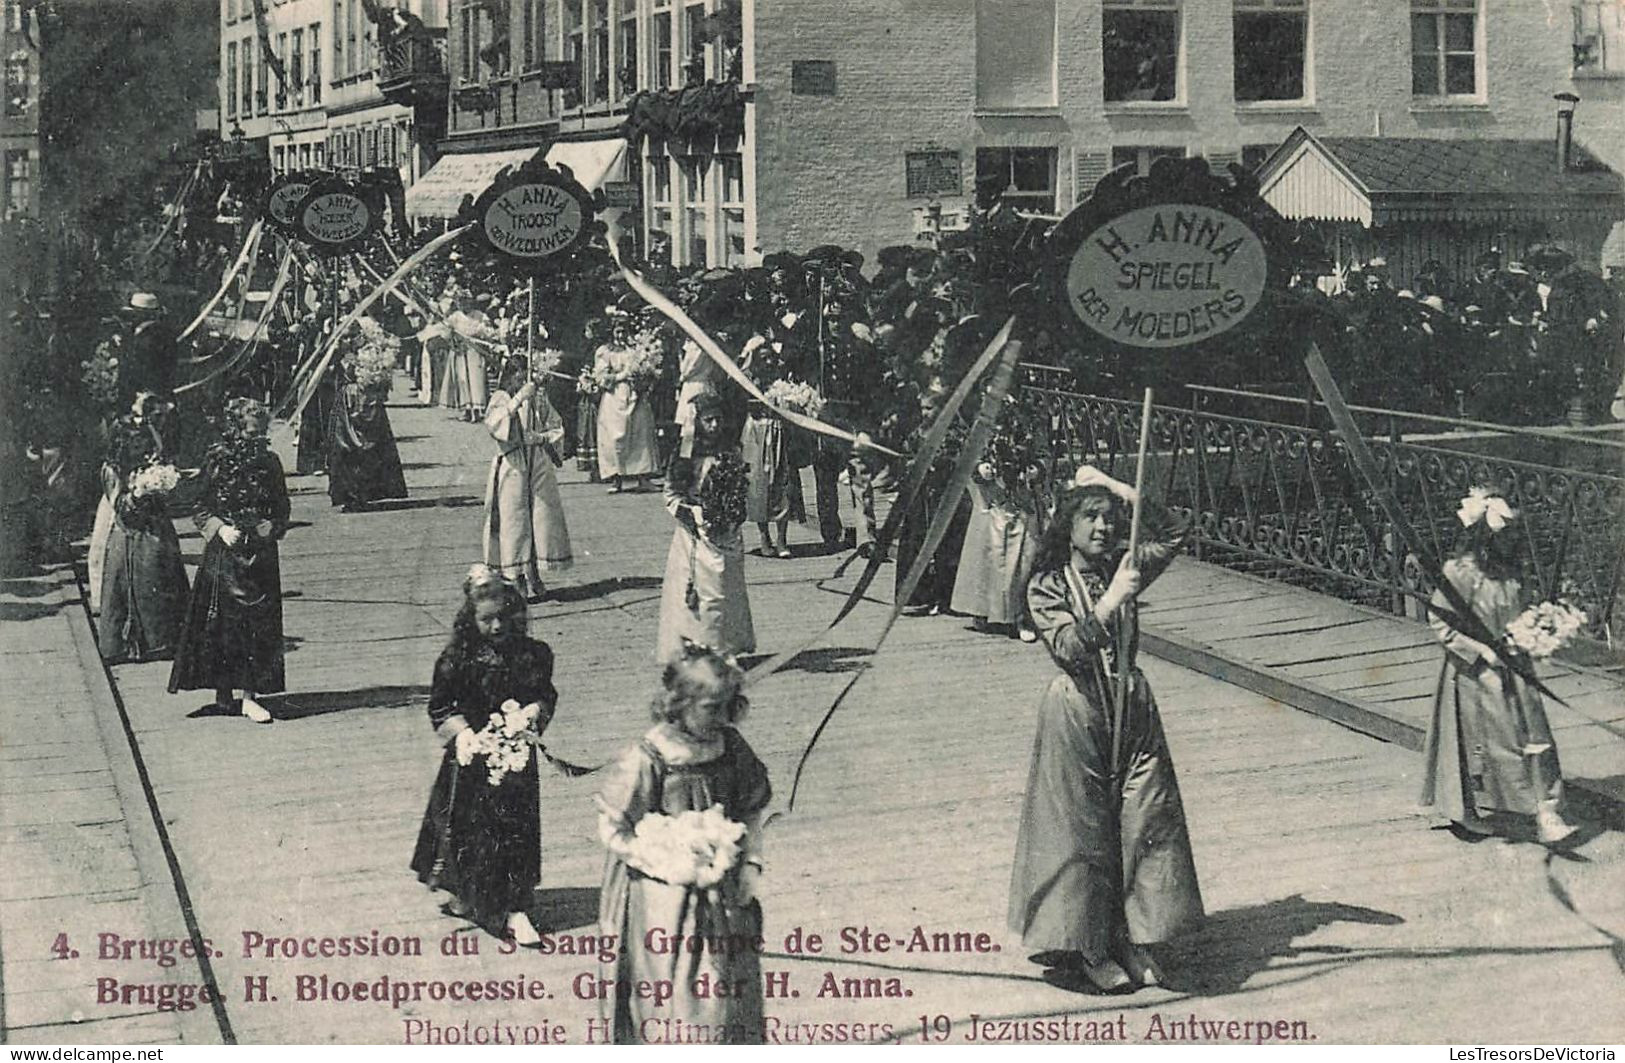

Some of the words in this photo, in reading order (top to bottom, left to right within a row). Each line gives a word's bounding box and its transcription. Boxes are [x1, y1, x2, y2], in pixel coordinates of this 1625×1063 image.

[327, 195, 360, 215] ANNA
[522, 187, 570, 215] ANNA
[511, 211, 559, 230] TROOST
[504, 224, 575, 254] WEDUWEN
[1095, 226, 1140, 263] H.
[1148, 211, 1244, 265] ANNA
[1116, 261, 1221, 291] SPIEGEL
[1077, 287, 1111, 323] DER
[1112, 289, 1246, 340] MOEDERS
